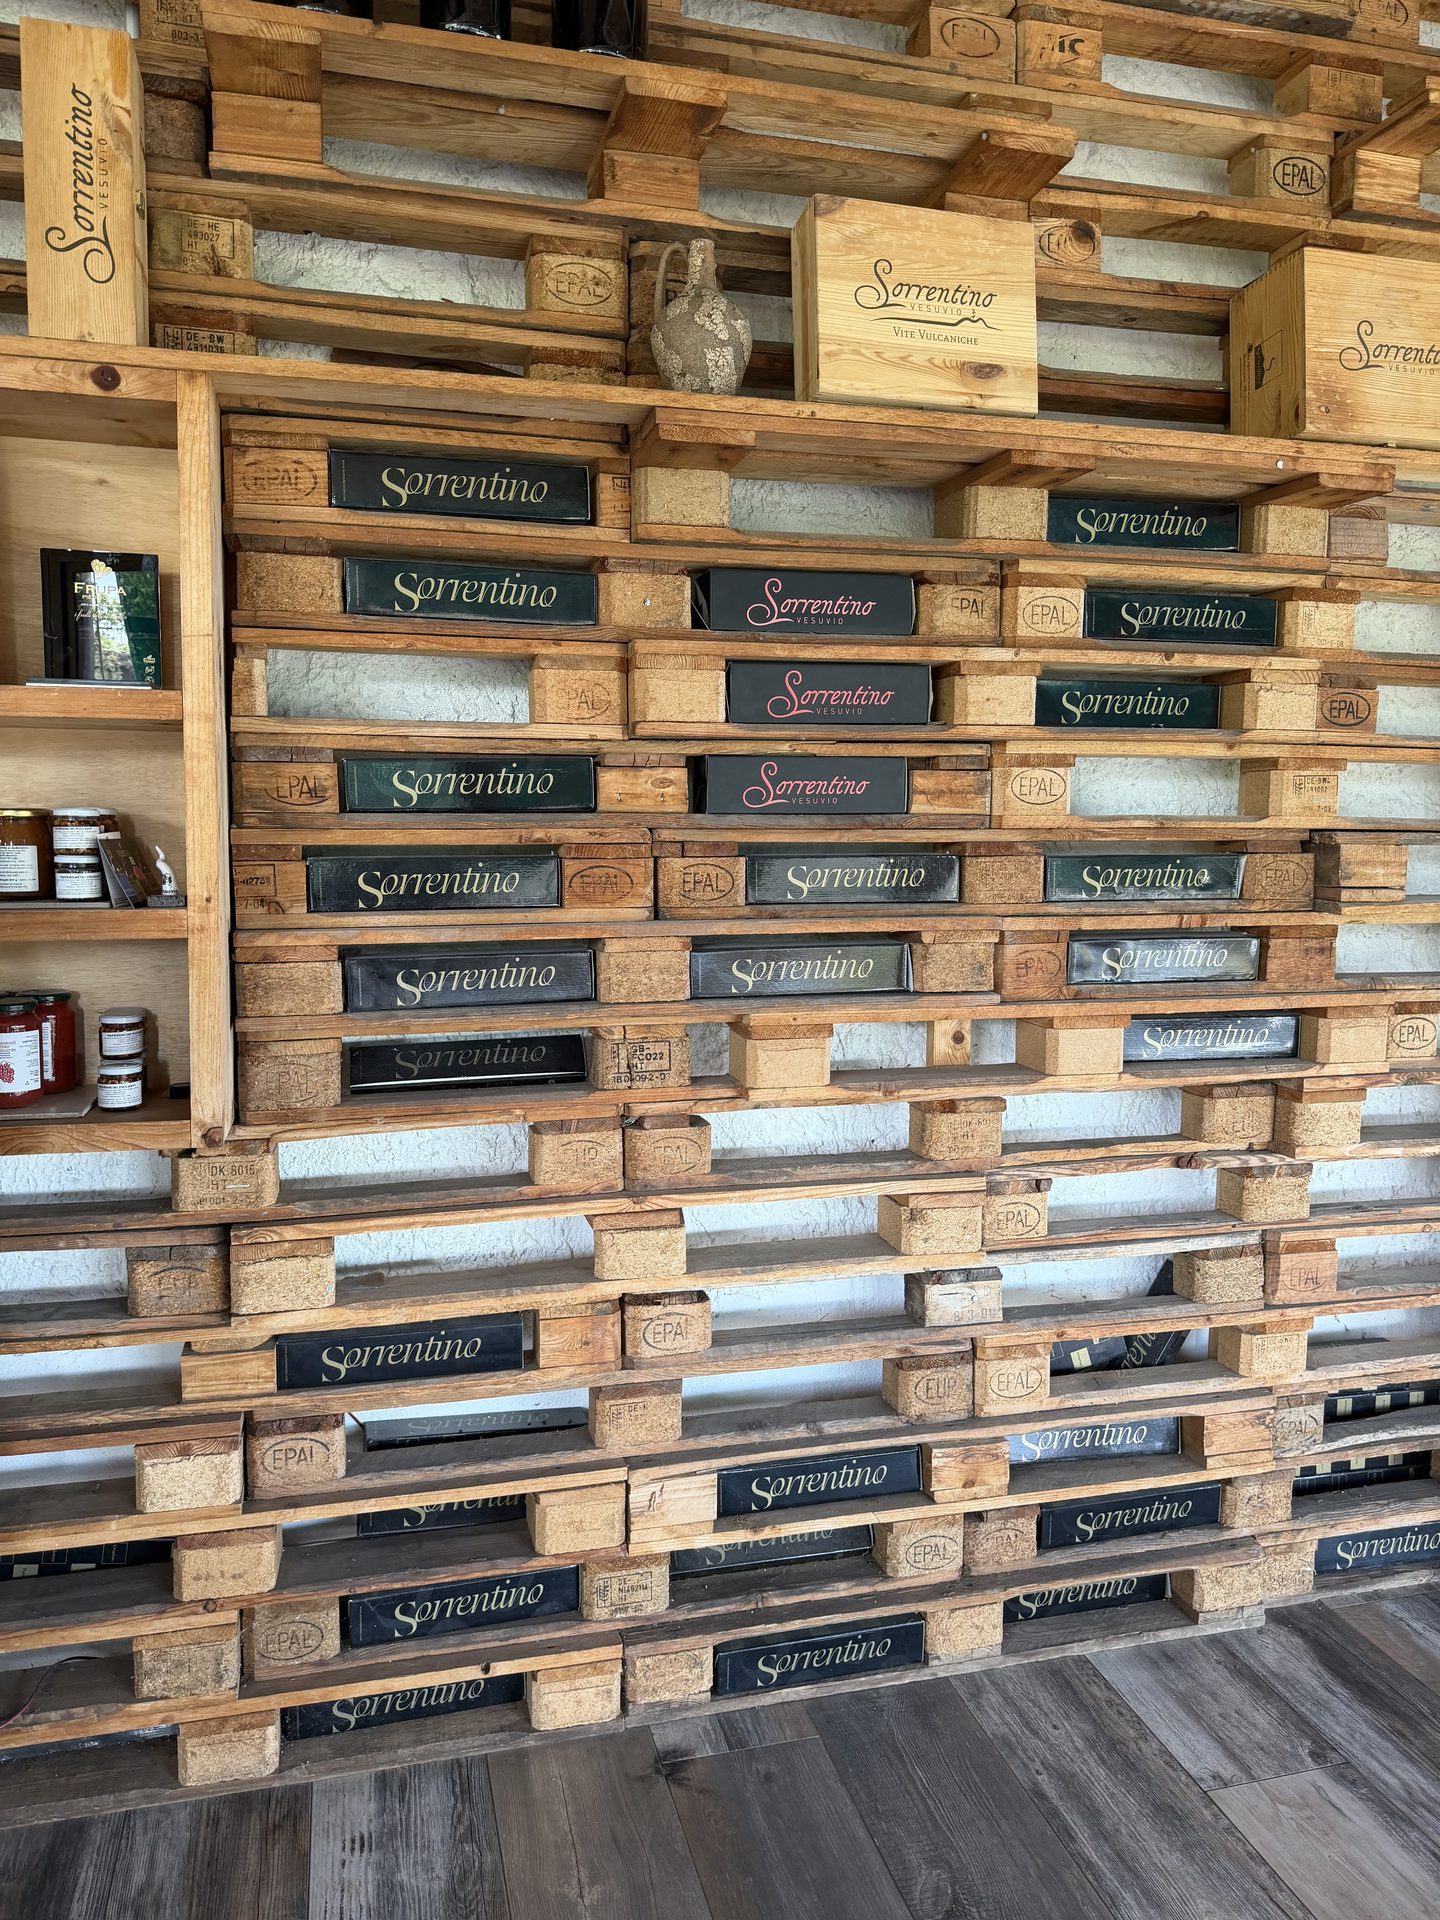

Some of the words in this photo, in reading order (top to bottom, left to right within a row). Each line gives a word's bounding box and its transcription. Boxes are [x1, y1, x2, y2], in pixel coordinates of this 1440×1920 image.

[45, 82, 116, 284] Sorrentino
[97, 137, 109, 209] VESUVIO
[1282, 163, 1317, 190] EPAL
[554, 269, 604, 298] EPAL
[854, 258, 998, 310] Sorrentino
[910, 303, 962, 316] VESUVIO
[893, 326, 916, 339] VITE
[918, 329, 979, 346] VULCANICHE
[1388, 364, 1435, 376] VESUVIO
[381, 466, 548, 509] Sorrentino
[1074, 505, 1208, 544] Sorrentino
[393, 572, 557, 612] Sorrentino
[746, 577, 876, 626] Sorrentino
[796, 617, 844, 625] VESUVIO
[1030, 604, 1071, 627] EPAL
[1119, 599, 1247, 637] Sorrentino
[767, 670, 895, 719] Sorrentino
[815, 707, 863, 715] VESUVIO
[1060, 686, 1190, 725] Sorrentino
[1328, 699, 1365, 720] EPAL
[277, 775, 323, 799] EPAL
[391, 763, 555, 808] Sorrentino
[742, 761, 871, 808] Sorrentino
[791, 797, 838, 805] VESUVIO
[1018, 776, 1059, 797] EPAL
[357, 862, 520, 909] Sorrentino
[682, 871, 726, 894] EPAL
[786, 858, 926, 900] Sorrentino
[1081, 858, 1209, 899] Sorrentino
[731, 949, 874, 993] Sorrentino
[1101, 940, 1228, 981] Sorrentino
[395, 956, 556, 1007] Sorrentino
[1142, 1019, 1269, 1058] Sorrentino
[1399, 1025, 1431, 1045] EPAL
[395, 1039, 547, 1080] Sorrentino
[996, 1208, 1034, 1229] EPAL
[1288, 1267, 1321, 1287] EPAL
[321, 1329, 482, 1382] Sorrentino
[996, 1372, 1036, 1393] EPAL
[408, 1411, 550, 1433] Sorrentino
[1021, 1424, 1148, 1463] Sorrentino
[751, 1459, 888, 1511] Sorrentino
[403, 1494, 525, 1527] Sorrenti
[1075, 1496, 1193, 1542] Sorrentino
[913, 1542, 956, 1564] EPAL
[1335, 1527, 1440, 1571] Sorrentino
[393, 1578, 545, 1638] Sorrentino
[1018, 1577, 1138, 1620] Sorrentino
[264, 1631, 312, 1652] EPAL
[757, 1635, 892, 1687] Sorrentino
[331, 1680, 485, 1734] Sorrentino
